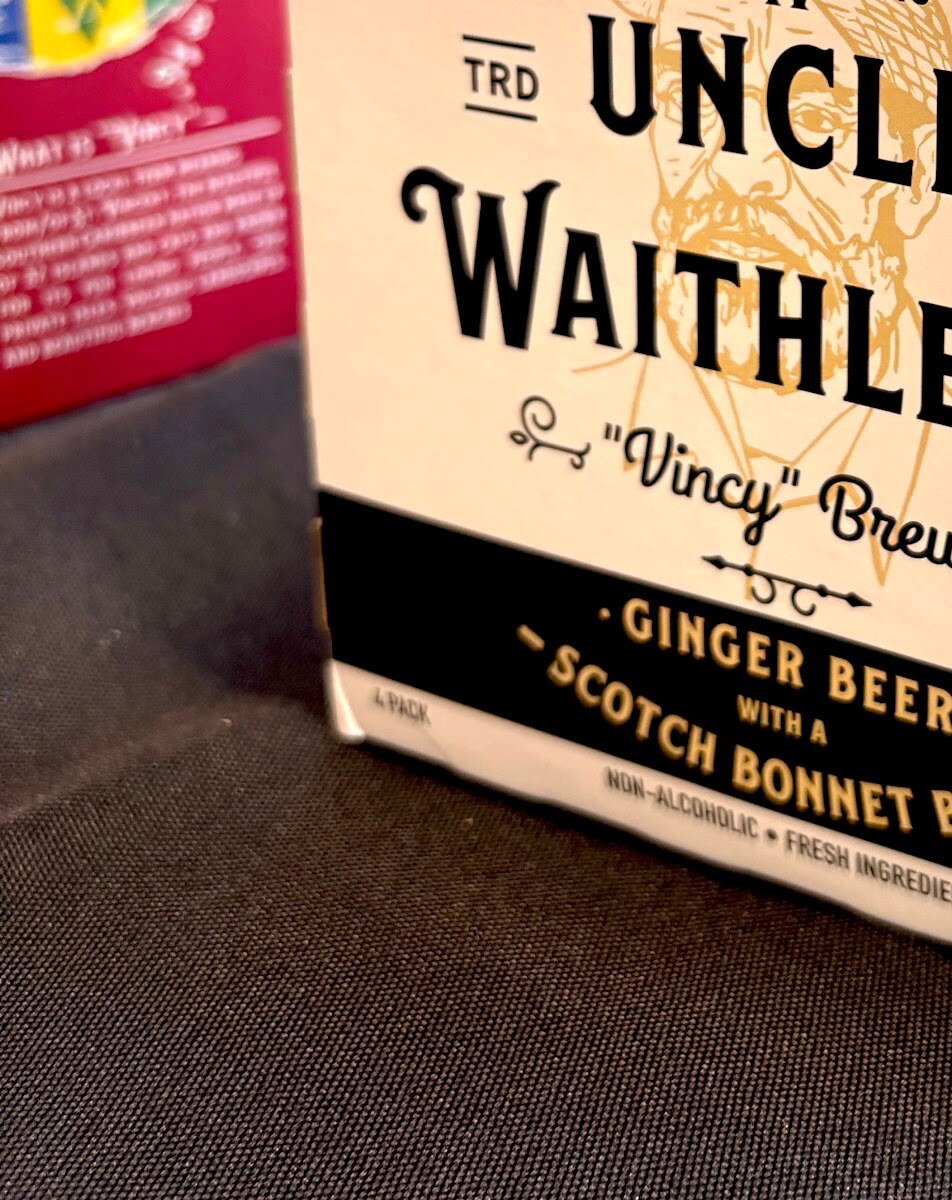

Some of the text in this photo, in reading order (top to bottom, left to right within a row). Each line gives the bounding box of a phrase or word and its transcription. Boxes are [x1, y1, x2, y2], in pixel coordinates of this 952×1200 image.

[463, 56, 540, 103] TRD
[603, 422, 801, 546] "Vincy"
[621, 598, 804, 688] GINGER
[547, 644, 717, 774] SCOTCH
[731, 744, 914, 832] BONNET
[736, 694, 829, 746] WITH A
[605, 765, 760, 840] NON-ALCOHOLIC
[783, 828, 850, 871] FRESH
